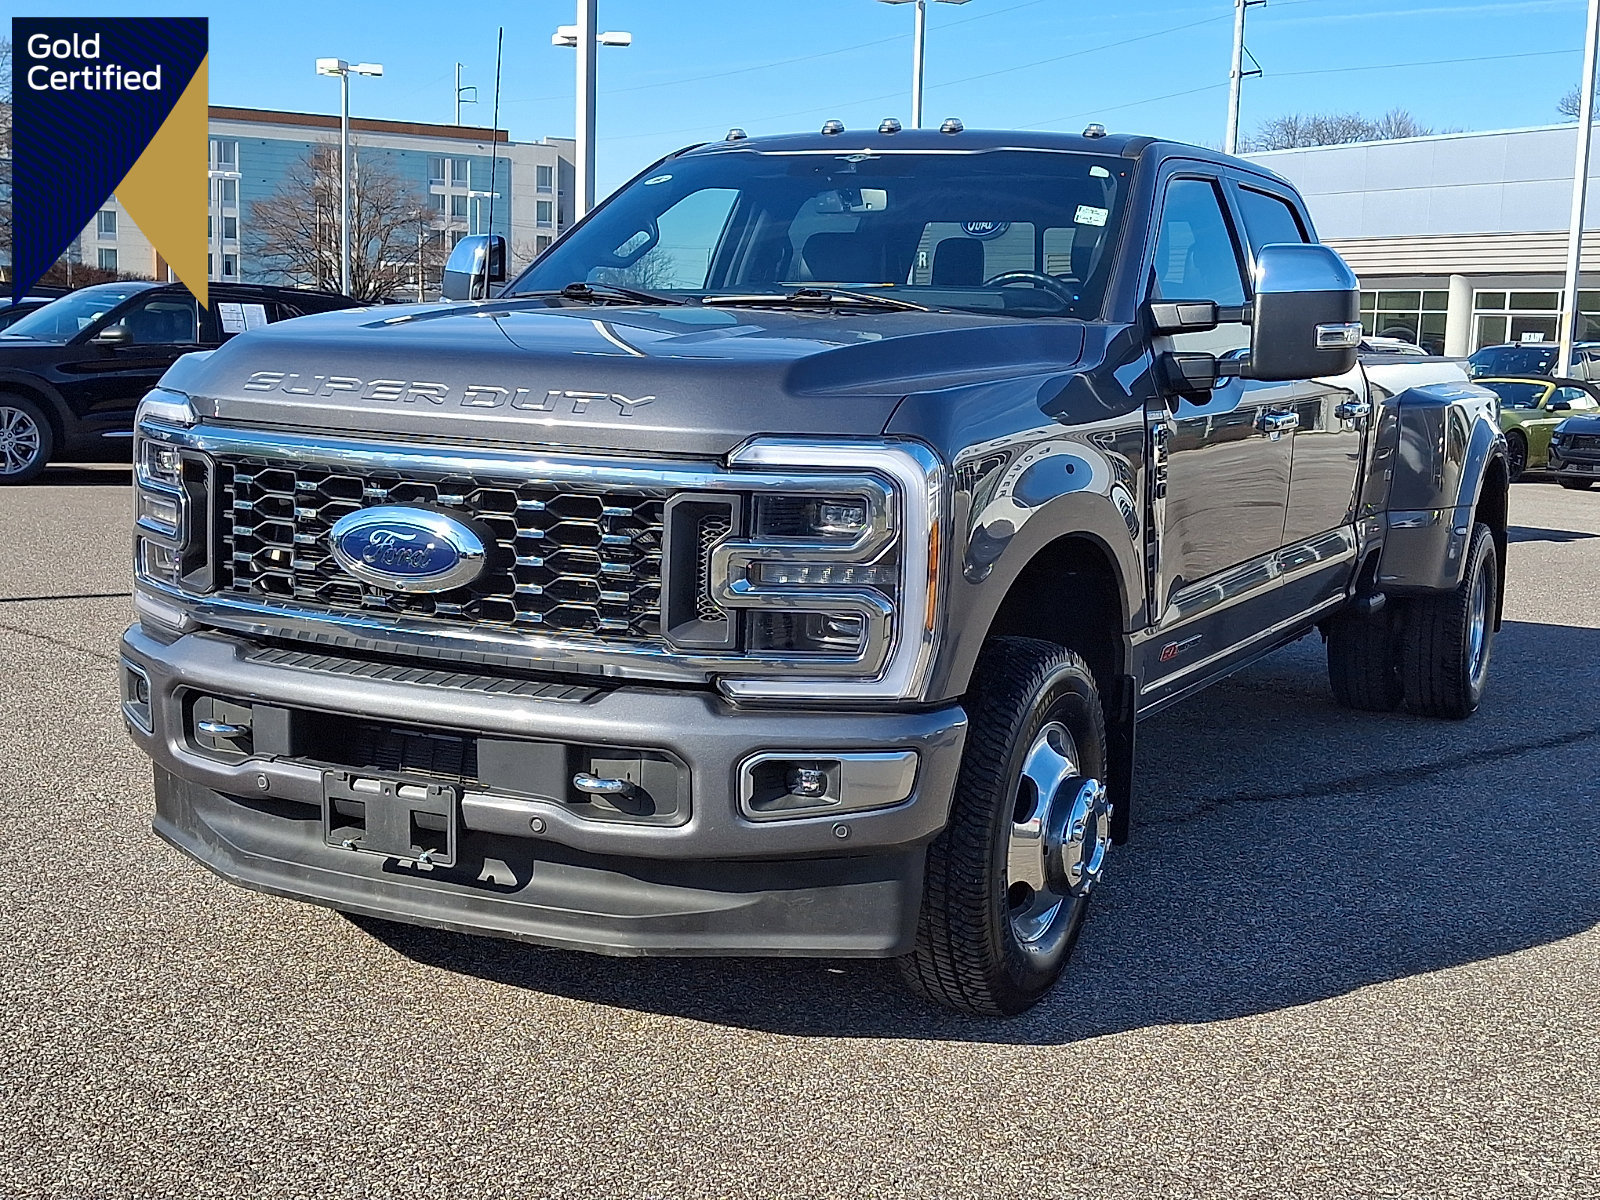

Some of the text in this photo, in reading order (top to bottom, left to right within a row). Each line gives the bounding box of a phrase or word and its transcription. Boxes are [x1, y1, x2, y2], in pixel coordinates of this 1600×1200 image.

[243, 370, 656, 417] SUPER DUTY
[362, 529, 436, 569] Ford
